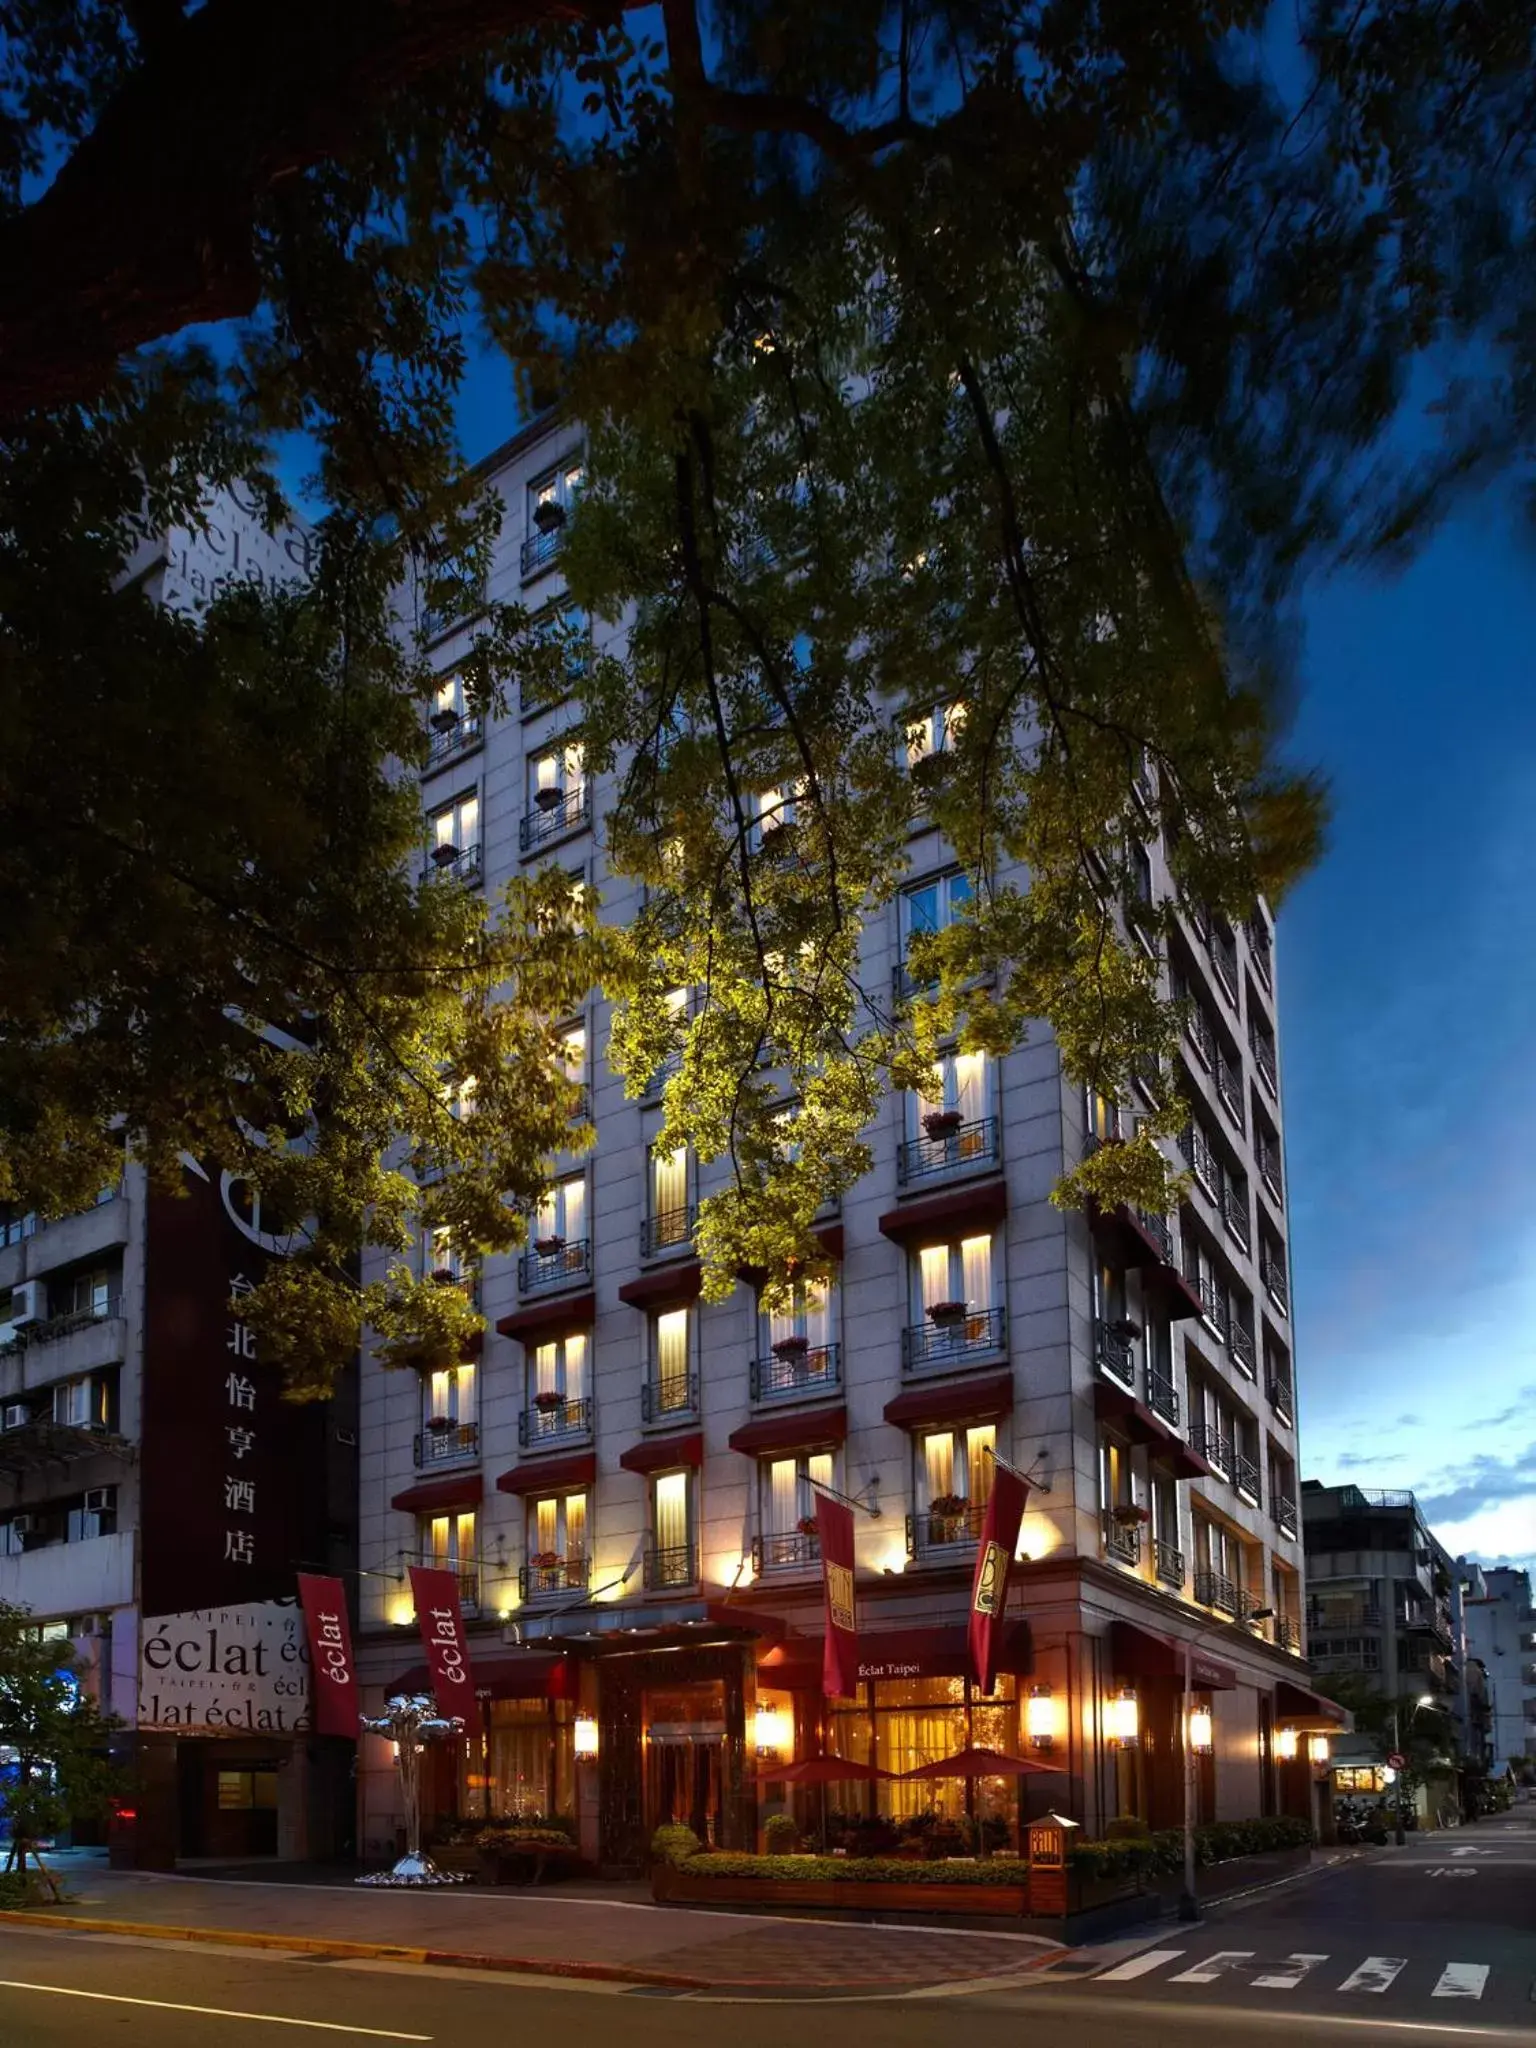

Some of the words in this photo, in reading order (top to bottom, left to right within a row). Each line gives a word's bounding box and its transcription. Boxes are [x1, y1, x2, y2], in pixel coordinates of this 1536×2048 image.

[144, 1624, 269, 1676] éclat
[317, 1612, 350, 1685] éclat
[429, 1607, 467, 1684] éclat
[858, 1663, 885, 1676] Éclat
[886, 1662, 920, 1677] Taipei
[205, 1698, 289, 1732] éclat
